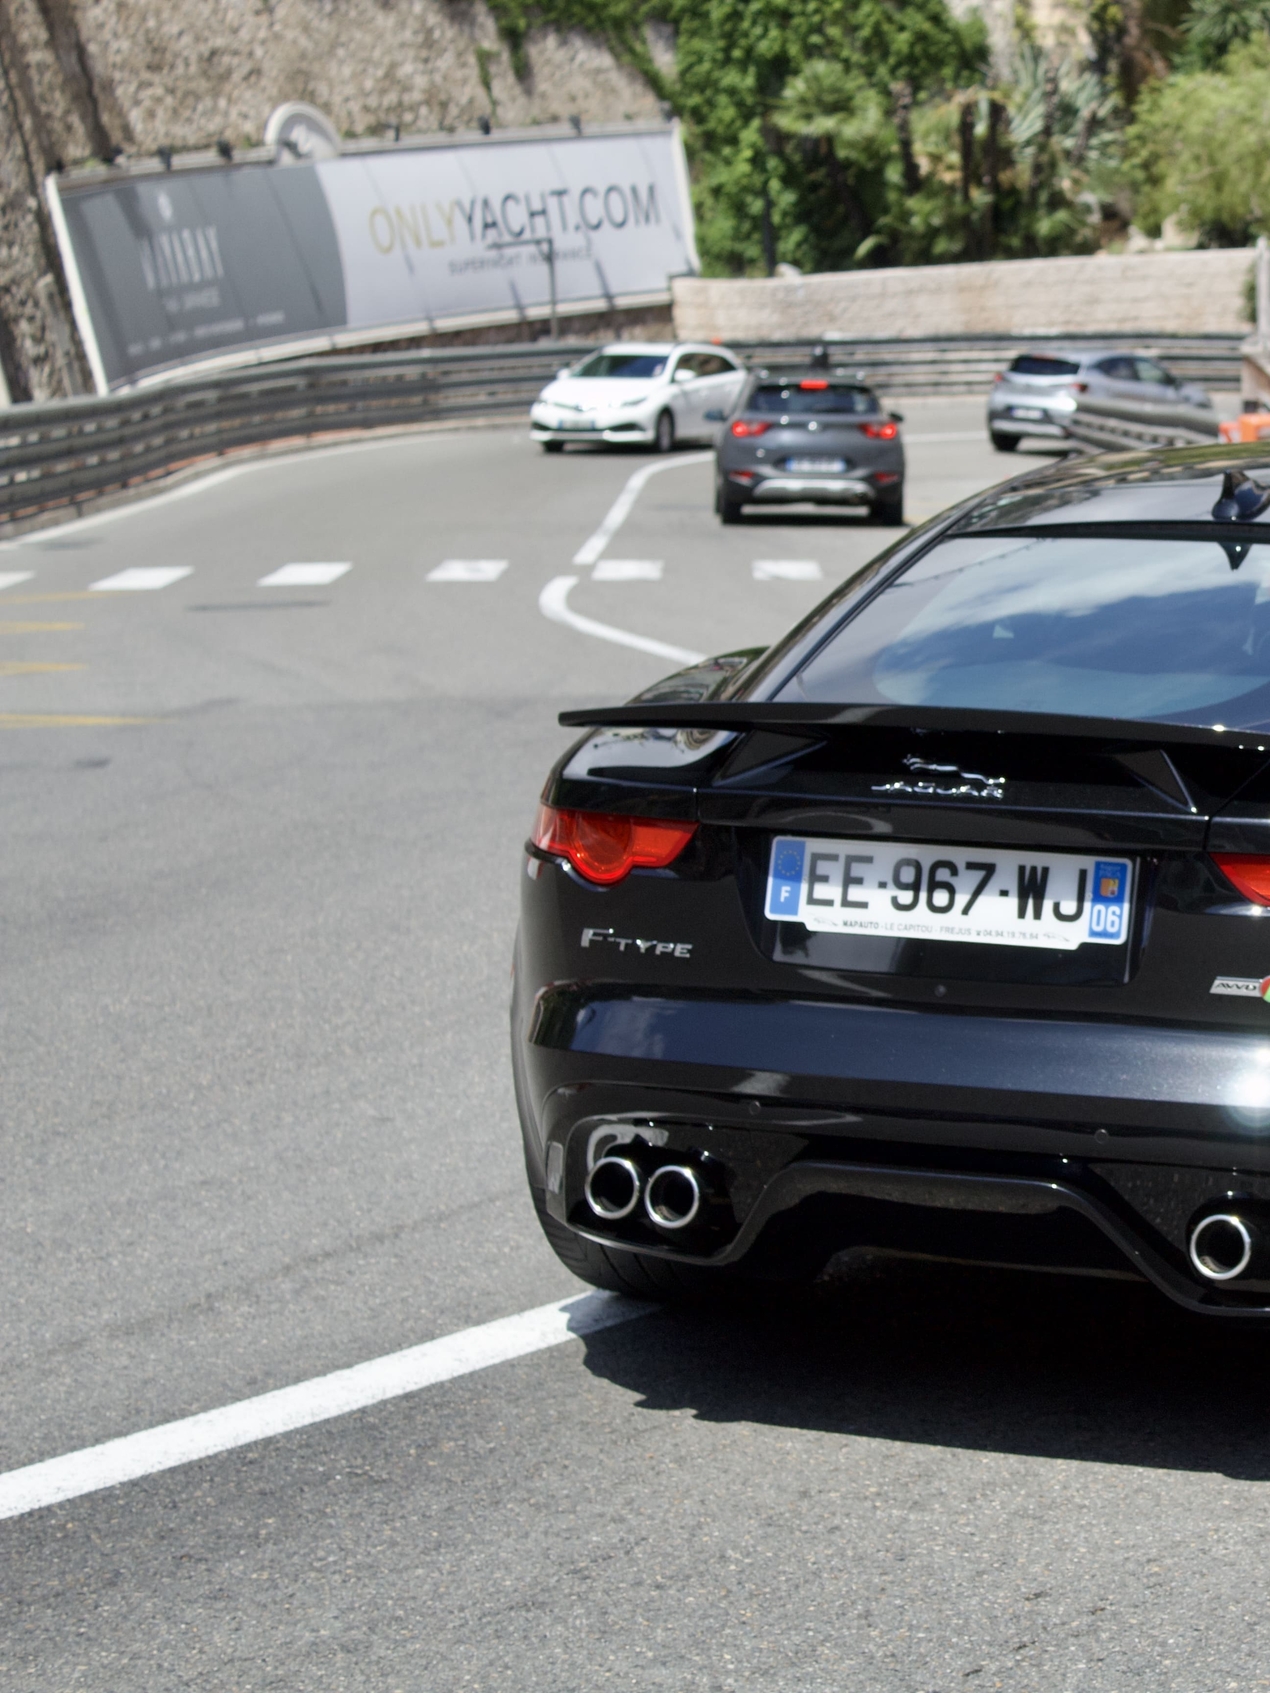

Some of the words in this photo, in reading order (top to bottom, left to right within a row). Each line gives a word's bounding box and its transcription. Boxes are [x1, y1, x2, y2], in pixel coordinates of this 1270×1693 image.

[368, 183, 661, 255] ONLYYACHT.COM
[870, 780, 1004, 799] JAGUAR
[780, 886, 791, 903] F
[805, 852, 1088, 923] EE-967-WJ
[842, 920, 880, 930] MAPAUTO
[884, 923, 896, 931] LE
[897, 924, 934, 933] CAPITOU
[1091, 904, 1121, 933] 06
[580, 926, 694, 959] F-TYPE
